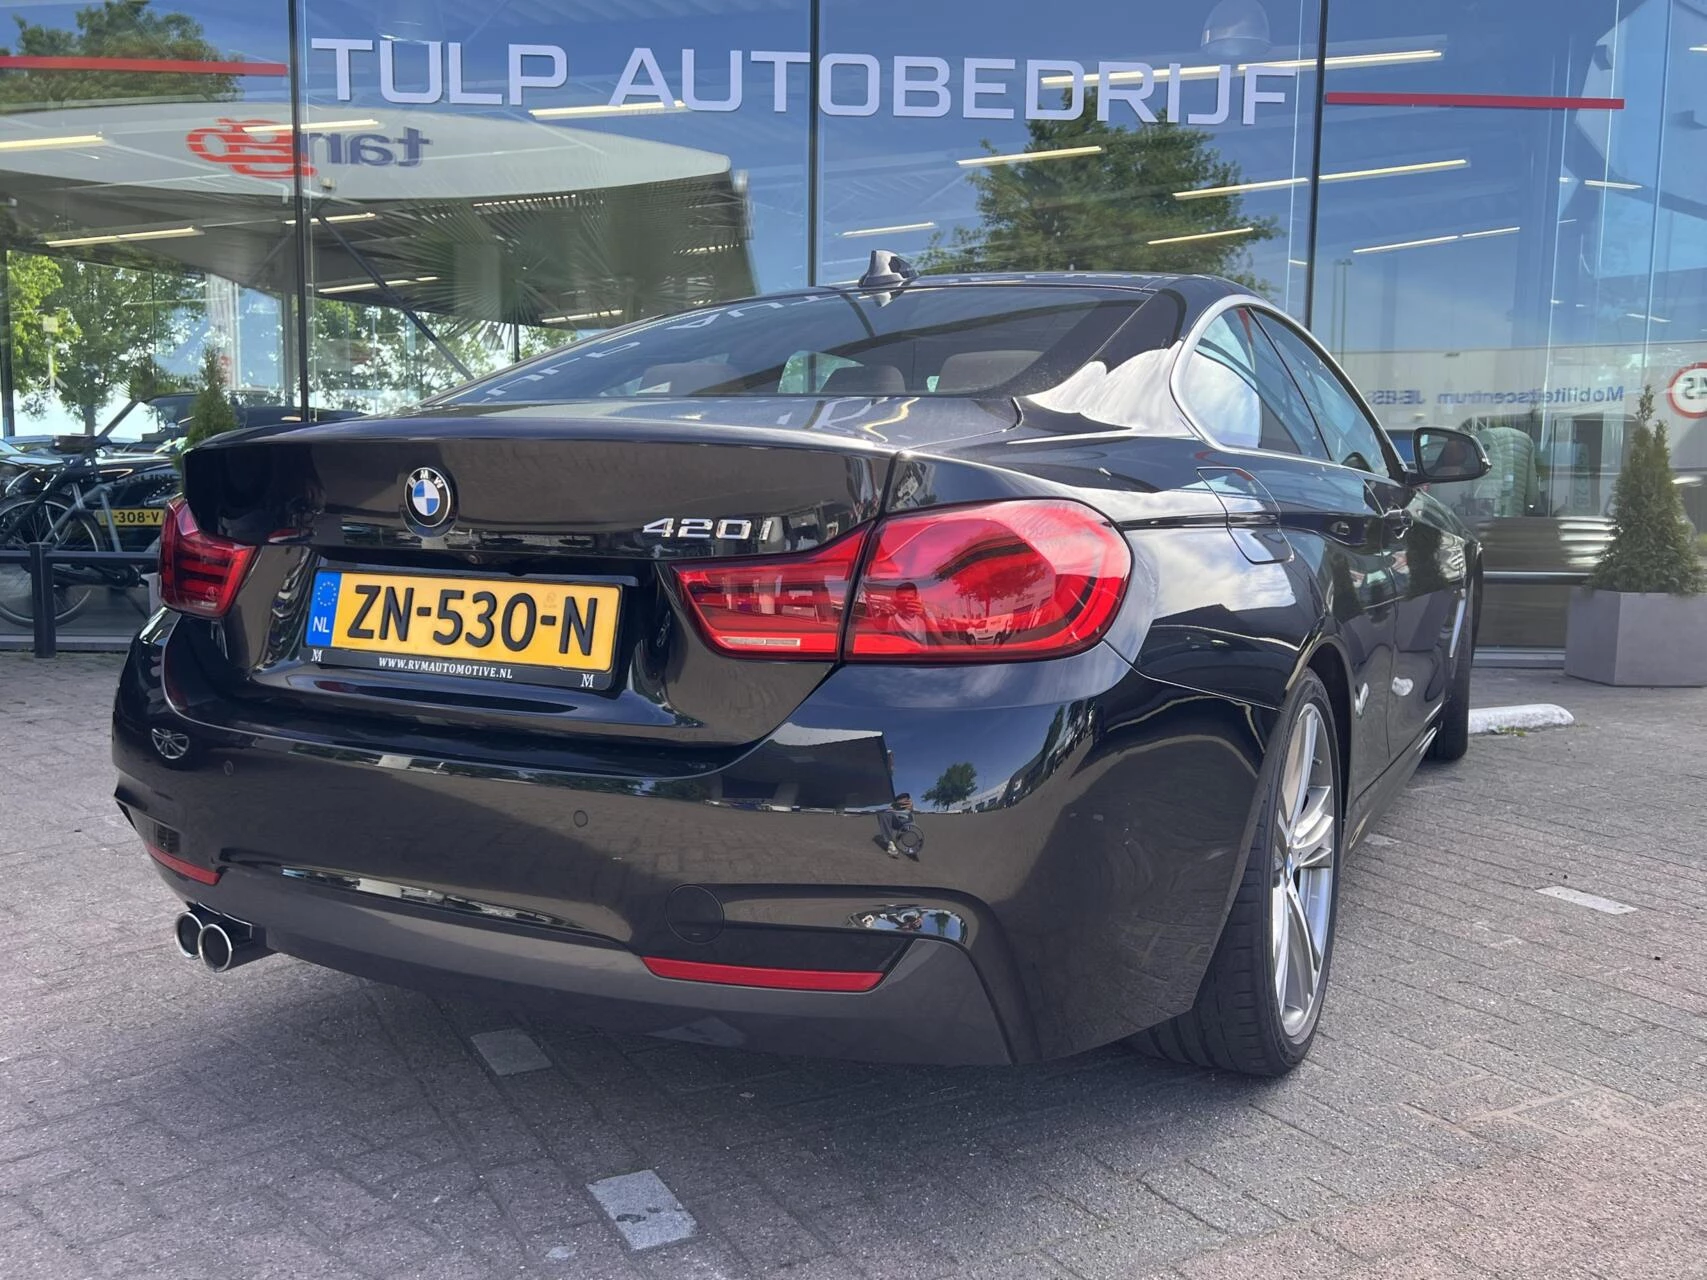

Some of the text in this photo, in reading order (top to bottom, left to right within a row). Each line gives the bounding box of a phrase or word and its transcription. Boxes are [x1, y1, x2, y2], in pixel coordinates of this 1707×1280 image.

[311, 38, 1297, 125] TULP AUTOBEDRIJF
[407, 469, 445, 490] BMW
[312, 615, 330, 633] NL
[347, 584, 599, 657] ZN-530-N
[378, 656, 513, 680] WWW.RVMAUTOMOTIVE.NL
